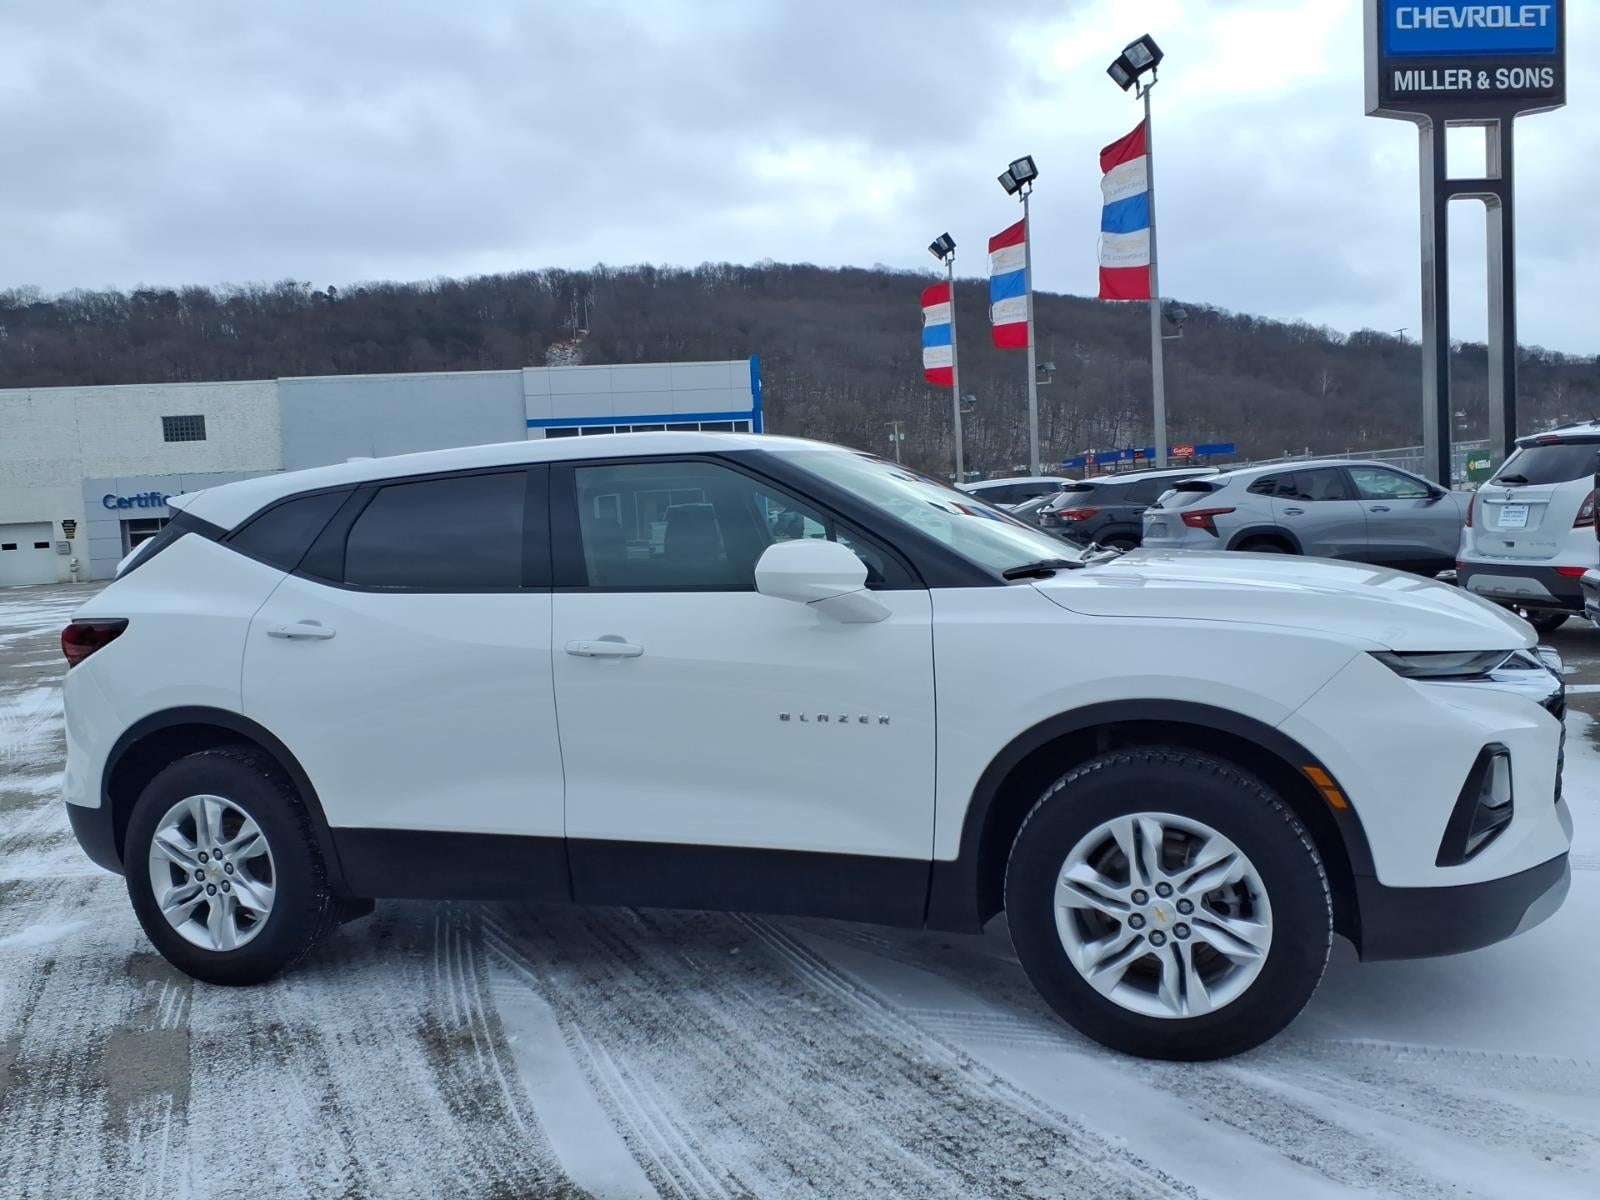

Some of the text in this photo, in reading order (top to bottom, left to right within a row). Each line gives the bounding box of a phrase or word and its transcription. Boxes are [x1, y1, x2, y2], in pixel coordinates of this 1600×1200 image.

[1396, 5, 1551, 29] CHEVROLET
[1394, 68, 1554, 91] MILLER & SONS
[102, 491, 182, 510] Certifi
[779, 712, 890, 725] BLAZER
